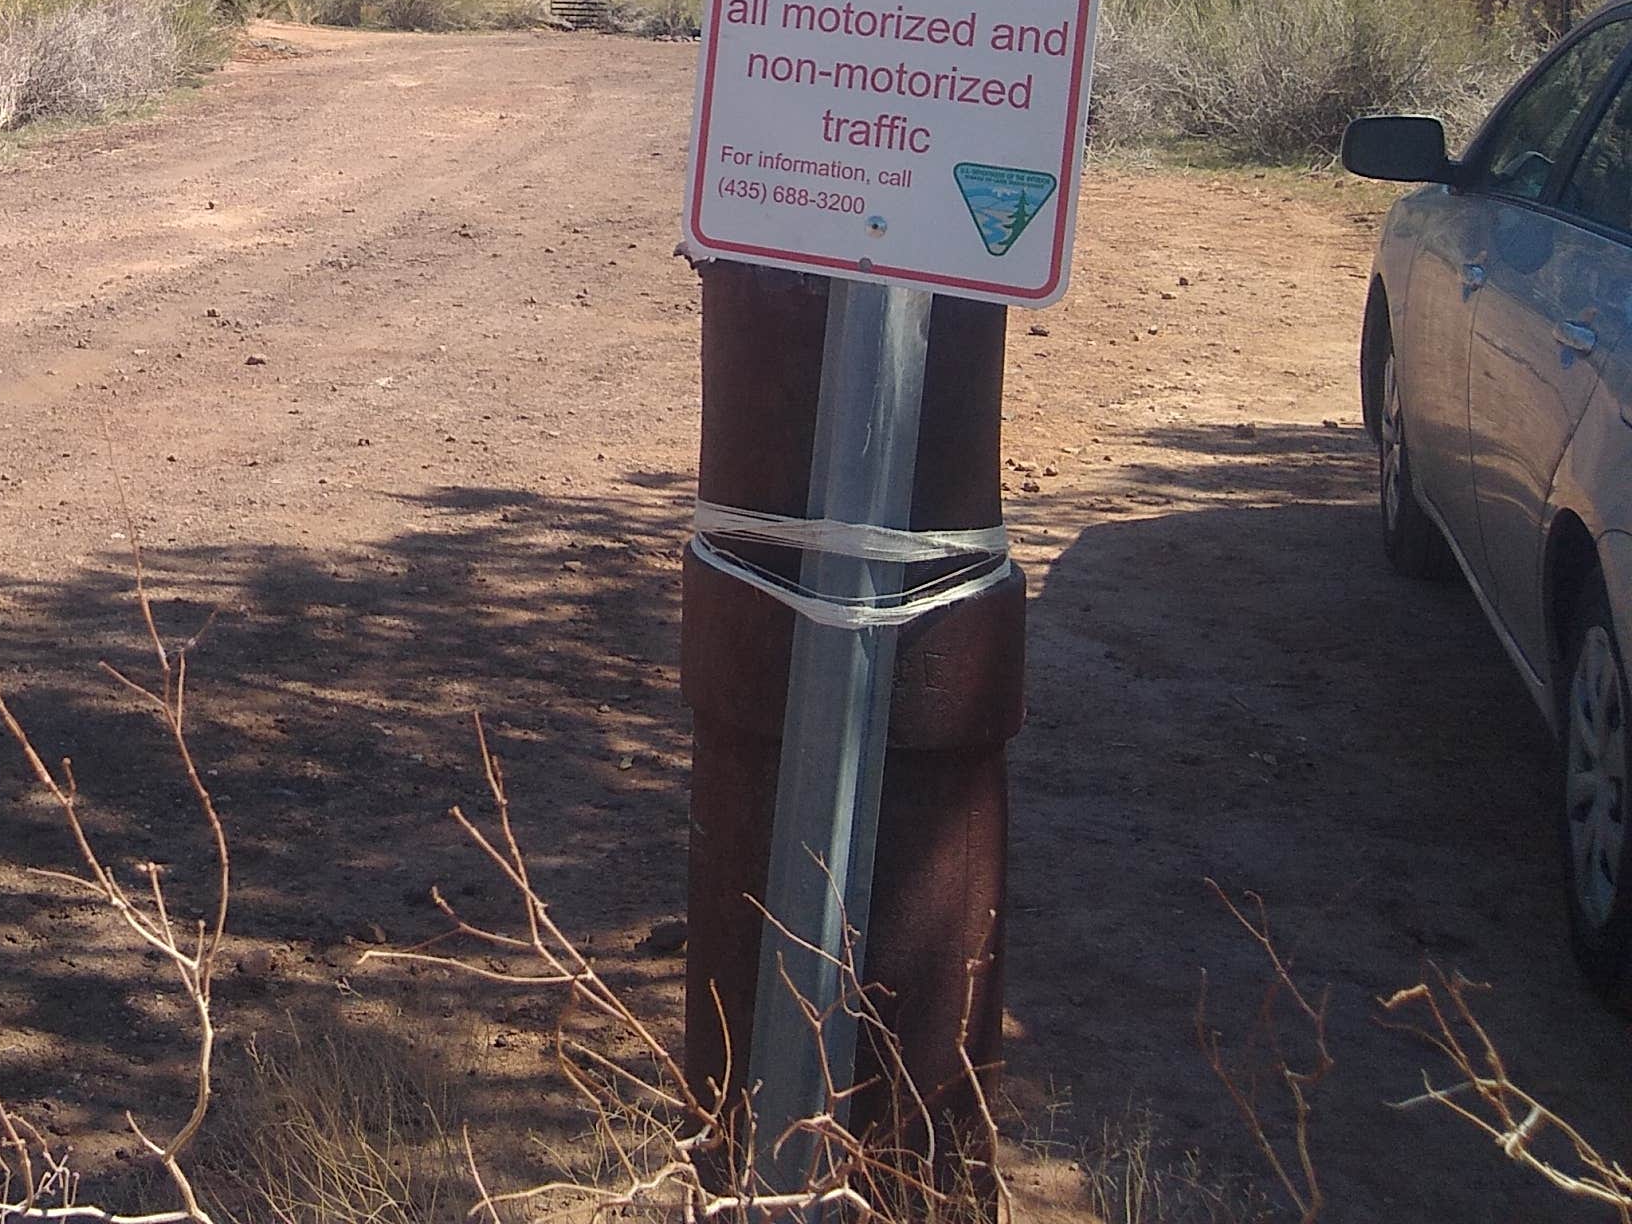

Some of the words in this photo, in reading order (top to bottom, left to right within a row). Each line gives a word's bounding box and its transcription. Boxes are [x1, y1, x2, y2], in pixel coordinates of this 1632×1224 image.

[781, 2, 976, 48] motorized
[990, 21, 1069, 57] and
[747, 53, 1033, 110] non-motorized
[821, 109, 931, 154] traffic
[720, 145, 754, 166] For
[758, 151, 871, 186] information,
[878, 169, 913, 188] call
[718, 176, 768, 205] (435)
[772, 184, 866, 215] 688-3200
